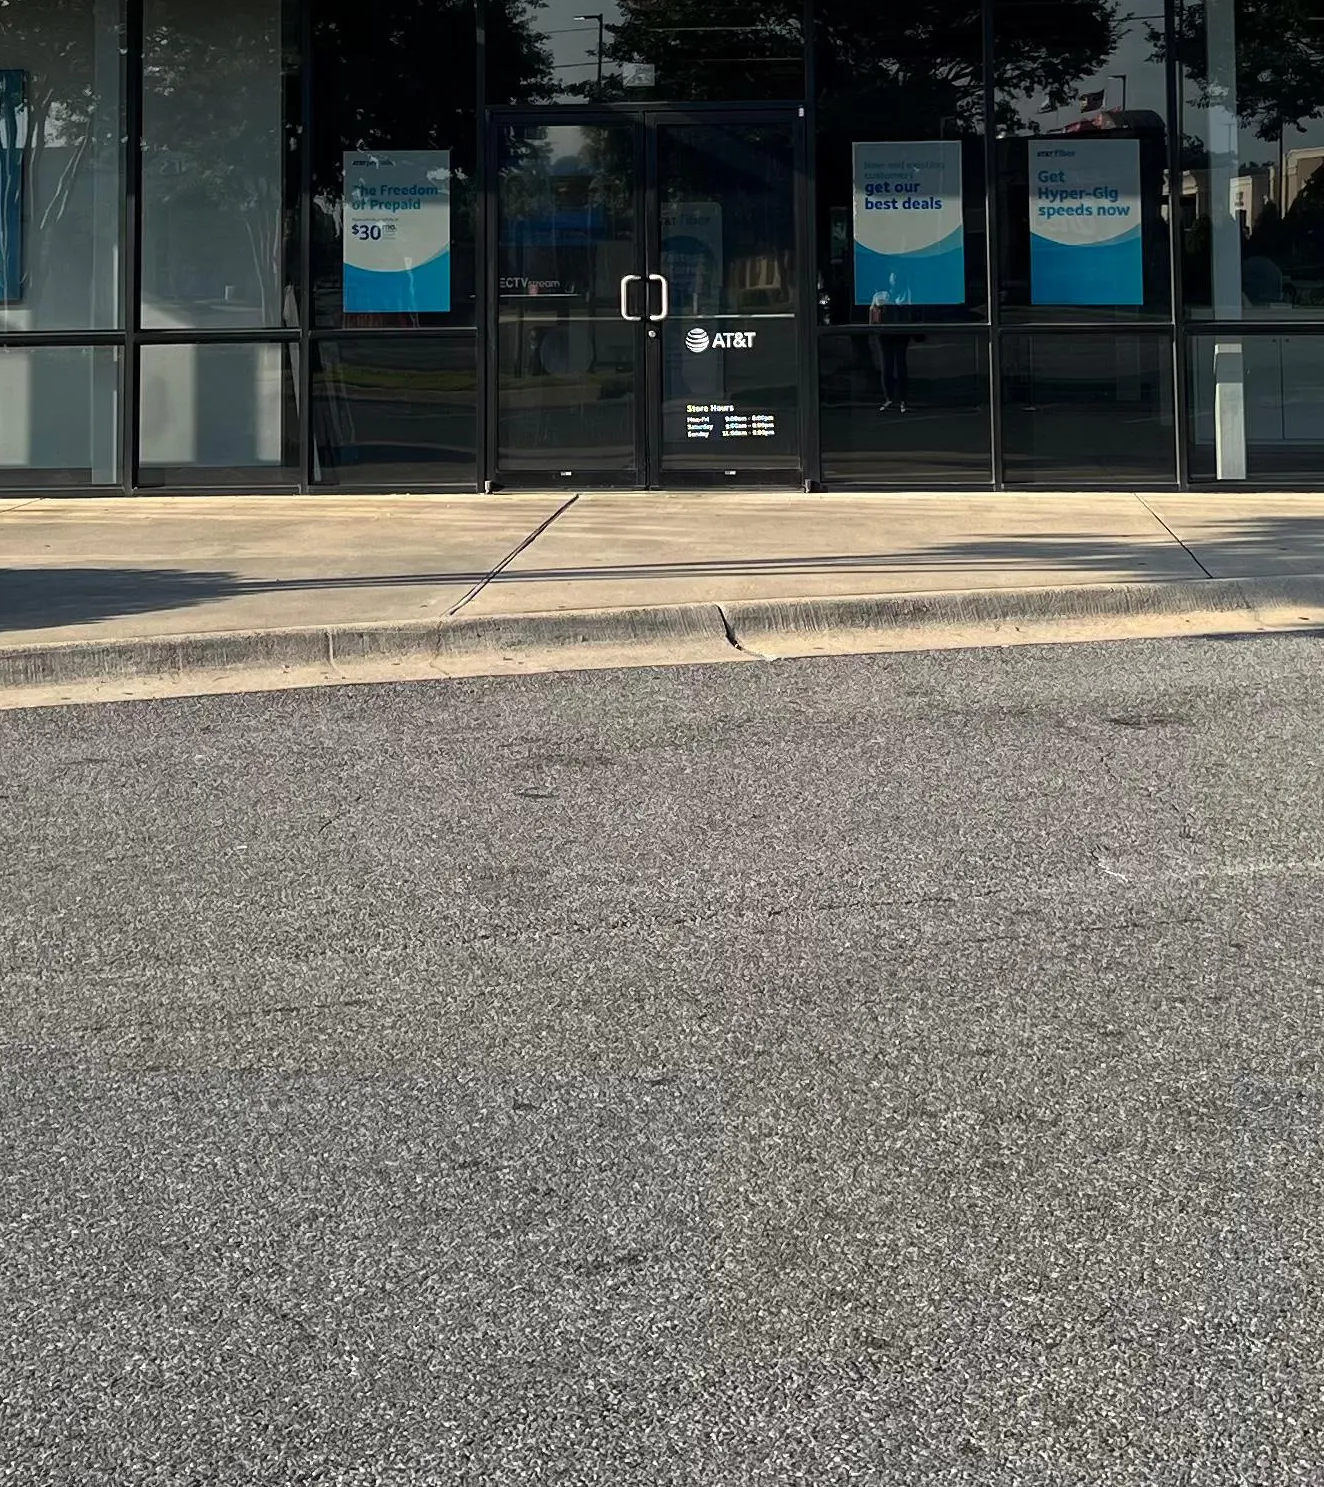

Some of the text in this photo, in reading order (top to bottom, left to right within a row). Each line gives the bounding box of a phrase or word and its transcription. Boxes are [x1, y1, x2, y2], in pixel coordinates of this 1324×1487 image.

[1038, 170, 1065, 183] Get
[381, 184, 438, 196] Freedom
[865, 181, 920, 196] get our
[1038, 185, 1119, 203] Hyper-Gig
[352, 198, 420, 213] of Prepaid
[865, 196, 942, 210] best deals
[1038, 203, 1130, 219] speeds now
[352, 224, 382, 240] $30
[712, 331, 756, 348] AT&T
[686, 404, 734, 412] Store Hours
